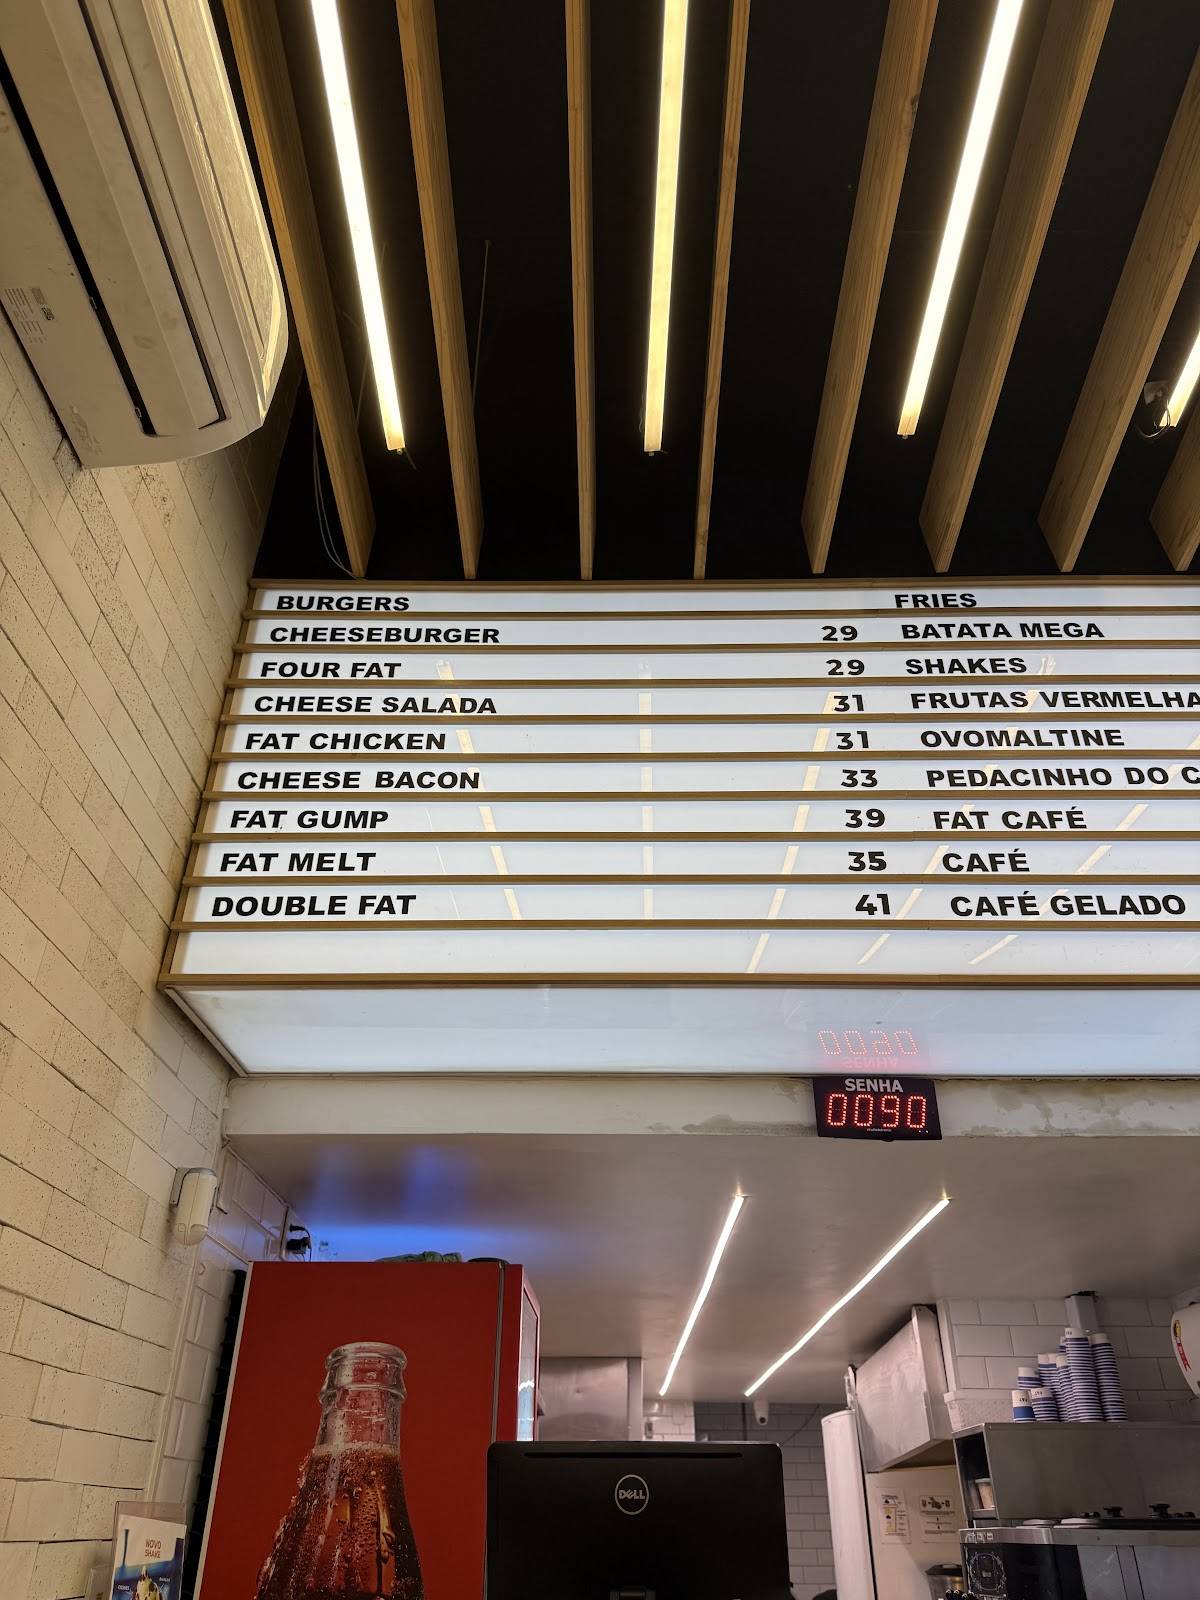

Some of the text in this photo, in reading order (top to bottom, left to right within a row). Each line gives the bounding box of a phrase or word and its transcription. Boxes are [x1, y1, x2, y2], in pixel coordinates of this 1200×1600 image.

[276, 595, 410, 612] BURGERS
[894, 593, 979, 610] FRIES
[269, 625, 858, 644] CHEESEBURGER 29
[901, 622, 1105, 640] BATATA MEGA
[260, 659, 865, 678] FOUR FAT 29
[905, 657, 1027, 675] SHAKES
[254, 694, 865, 714] CHEESE SALADA 31
[910, 691, 1200, 709] FRUTAS VERMELHA
[245, 730, 869, 750] FAT CHICKEN 31
[920, 729, 1125, 748] OVOMALTINE
[237, 769, 878, 790] CHEESE BACON 33
[926, 767, 1112, 788] PEDACINHO
[1123, 766, 1169, 785] DO
[230, 808, 886, 829] FAT GUMP 39
[933, 806, 1088, 830] FAT CAFÉ
[219, 851, 887, 872] FAT MELT 35
[942, 848, 1030, 873] CAFÉ
[211, 893, 891, 917] DOUBLE FAT 41
[950, 890, 1186, 917] CAFÉ GELADO
[844, 1078, 904, 1093] SENHA
[826, 1092, 928, 1129] 0090
[618, 1488, 646, 1500] DELL
[145, 1538, 162, 1549] NOVO
[144, 1549, 161, 1559] SHAKE
